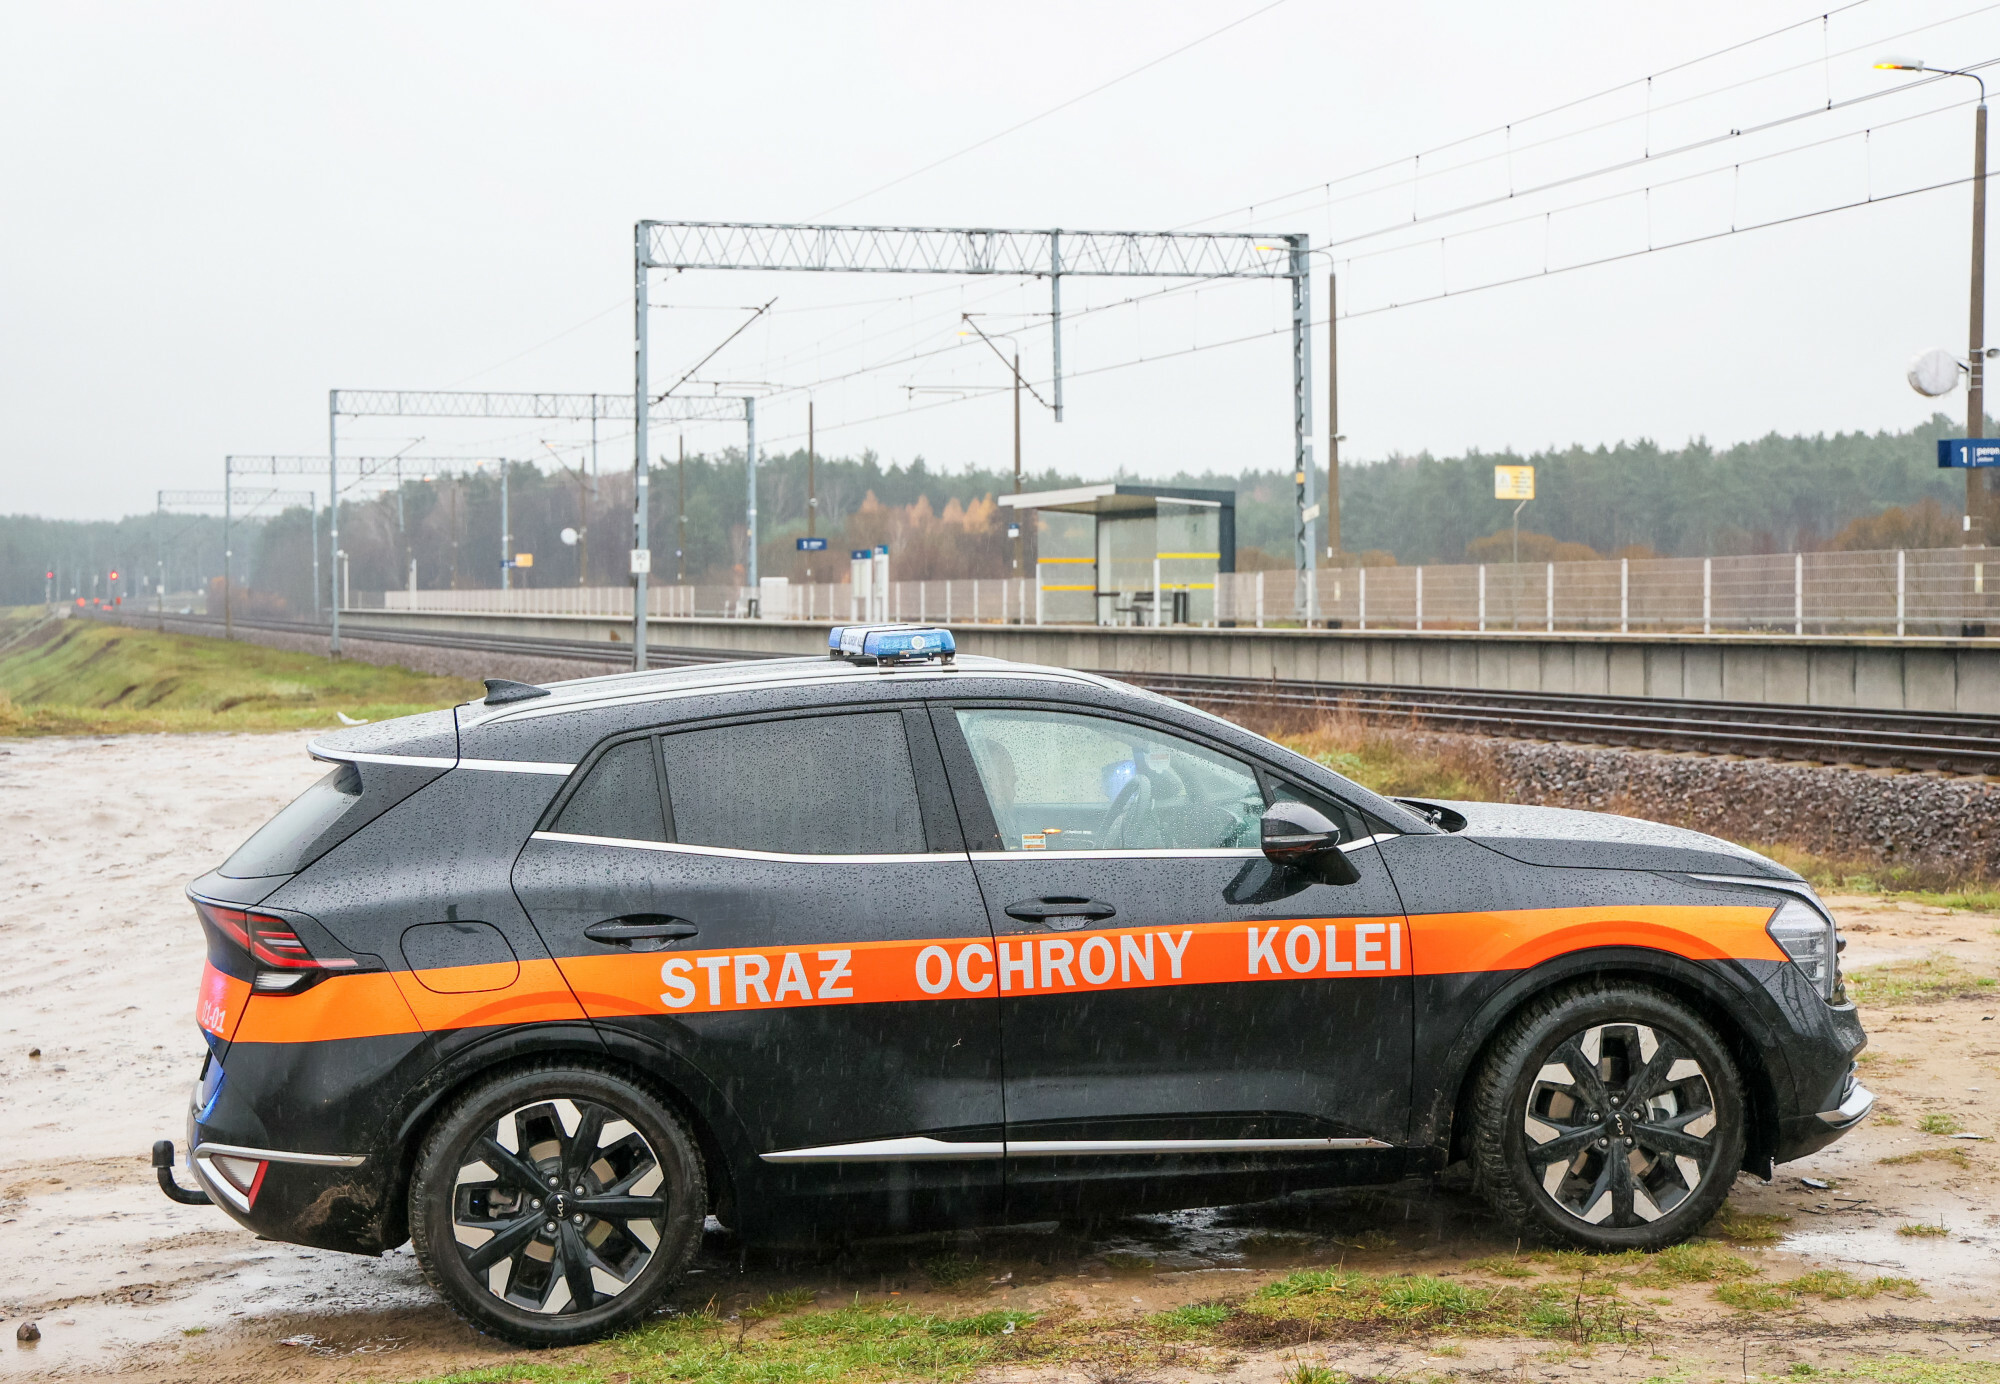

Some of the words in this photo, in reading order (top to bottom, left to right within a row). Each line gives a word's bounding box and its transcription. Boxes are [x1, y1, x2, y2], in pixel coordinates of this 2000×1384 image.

[1960, 446, 1968, 464] 1
[915, 931, 1193, 994] OCHRONY
[1248, 923, 1401, 974] KOLEI
